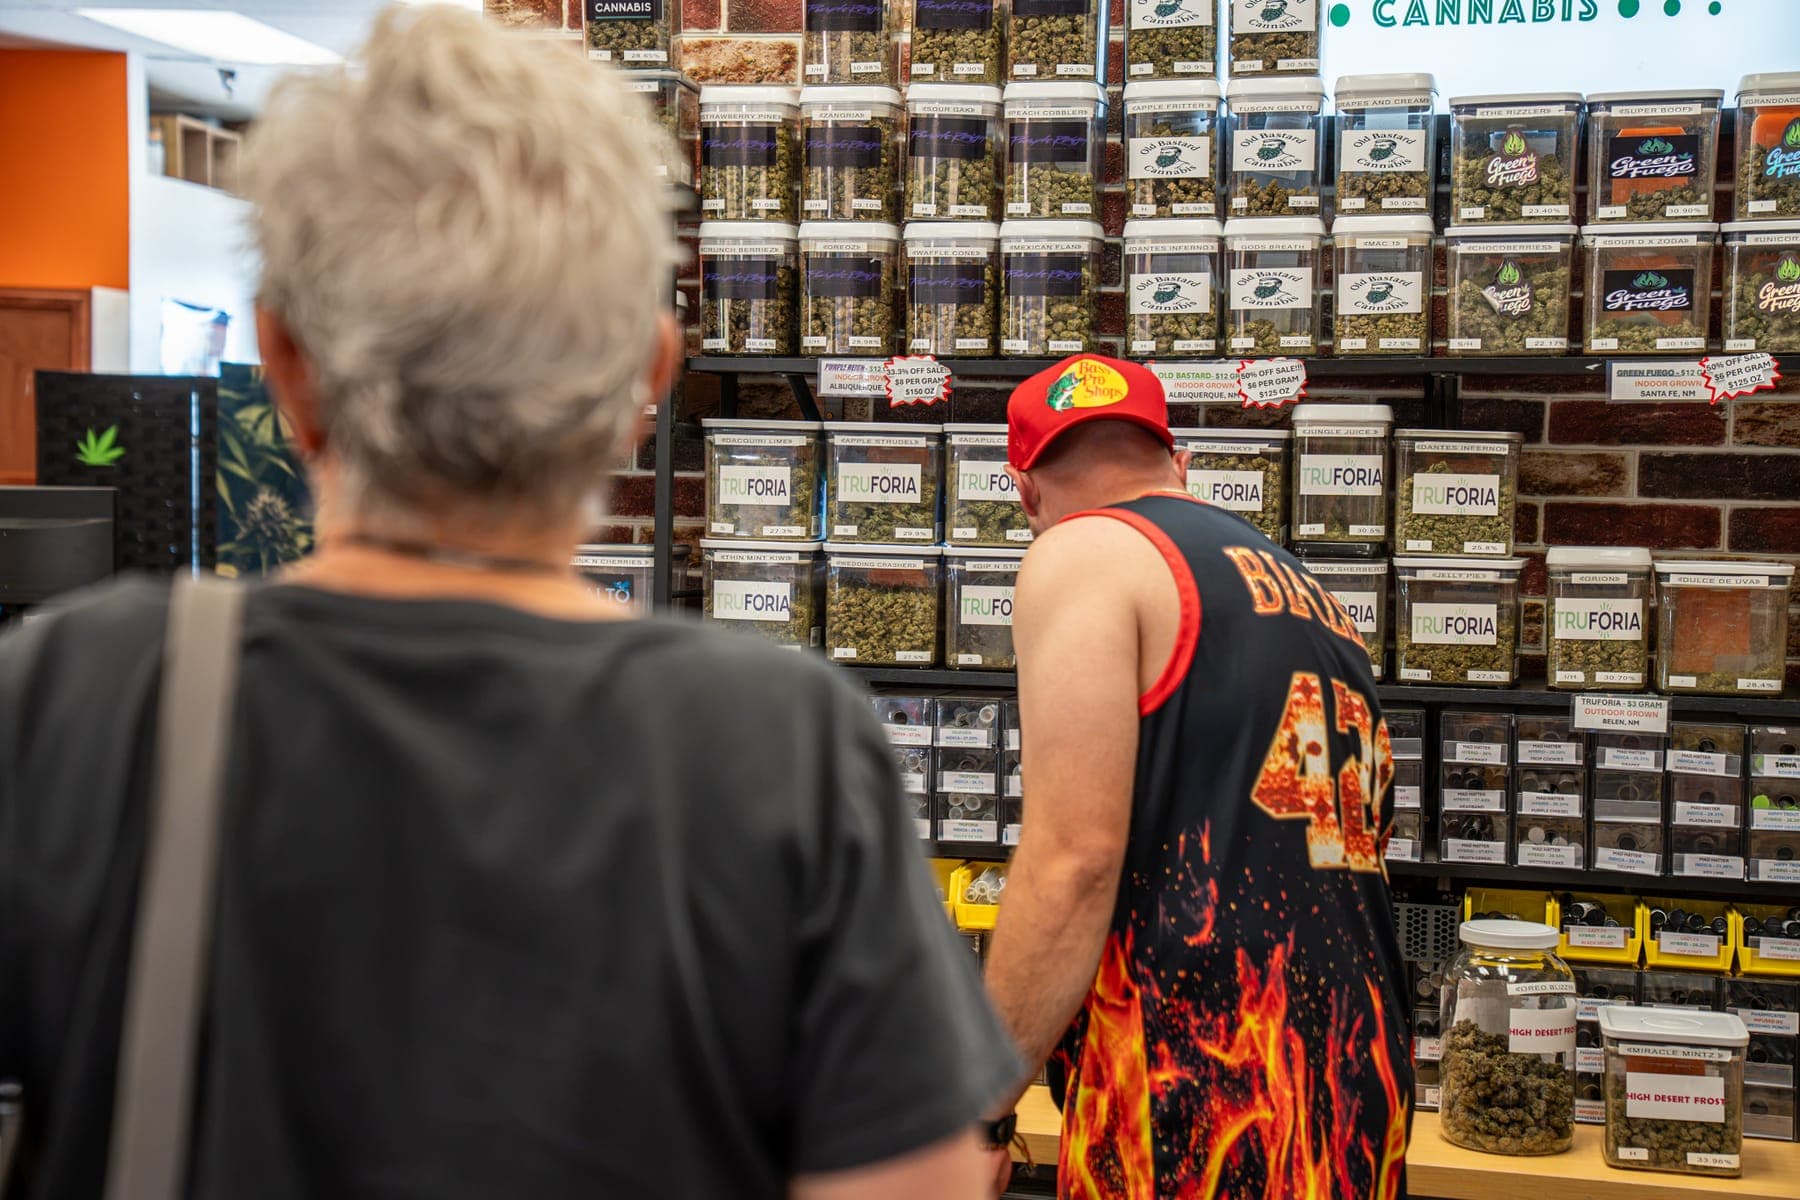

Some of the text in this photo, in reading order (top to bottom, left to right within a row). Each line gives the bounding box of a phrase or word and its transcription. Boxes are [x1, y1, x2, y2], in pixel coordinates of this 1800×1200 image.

[595, 2, 651, 13] CANNABIS
[1372, 0, 1598, 27] CANNABIS
[1142, 13, 1200, 25] Cannabis
[1248, 17, 1303, 29] Cannabis
[1240, 132, 1307, 147] Old Bastard
[1353, 133, 1417, 148] Old Bastard
[1140, 139, 1201, 155] Old Bastard
[1144, 164, 1197, 176] Cannabis
[1244, 157, 1303, 169] Cannabis
[1356, 157, 1413, 169] Cannabis
[1611, 154, 1677, 174] Green
[1629, 161, 1696, 179] Fuego
[1776, 161, 1800, 178] Fue
[1498, 169, 1538, 186] Fuego
[1136, 276, 1201, 291] Old Bastard
[1237, 271, 1304, 287] Old Bastard
[1350, 275, 1414, 291] Old Bastard
[1241, 295, 1299, 307] Cannabis
[1606, 289, 1672, 306] Green
[1624, 295, 1690, 311] Fuego
[1770, 296, 1800, 312] Fueg
[1140, 300, 1198, 311] Cannabis
[1354, 300, 1409, 311] Cannabis
[910, 367, 925, 375] OFF
[1079, 361, 1112, 375] Bass
[1706, 361, 1724, 372] 50%
[1725, 357, 1743, 367] OFF
[1713, 361, 1771, 382] $6 PER GRAM
[1082, 372, 1105, 385] Pro
[1240, 371, 1258, 380] 50%
[1258, 369, 1274, 377] OFF
[1617, 369, 1695, 377] GREEN FUEGO $12
[895, 378, 904, 386] $8
[922, 376, 945, 384] GRAM
[1247, 376, 1299, 389] $6 PER GRAM
[1728, 374, 1763, 388] $125 OZ
[1084, 385, 1124, 399] Shops
[1168, 391, 1226, 400] ALBUQUERQUE,
[1259, 387, 1290, 398] $125 OZ
[1668, 390, 1681, 398] FE,
[960, 472, 1017, 492] TRUFOR
[1302, 467, 1383, 487] TRUFORIA
[722, 477, 787, 497] TRUFORIA
[841, 475, 917, 494] TRUFORIA
[1415, 486, 1497, 506] TRUFORIA
[716, 592, 790, 612] TRUFORIA
[962, 597, 1013, 617] TRUFO
[1414, 615, 1495, 636] TRUFORIA
[1557, 610, 1641, 631] TRUFORIA
[1581, 697, 1663, 709] TRUFORIA $3 GRAM
[1584, 707, 1659, 718] OUTDOOR GROWN
[1602, 718, 1640, 727] BELEN, NM
[1509, 1026, 1577, 1037] HIGH DESERT FRO
[1682, 1050, 1716, 1059] MINTZ
[1626, 1092, 1726, 1105] HIGH DESERT FROST
